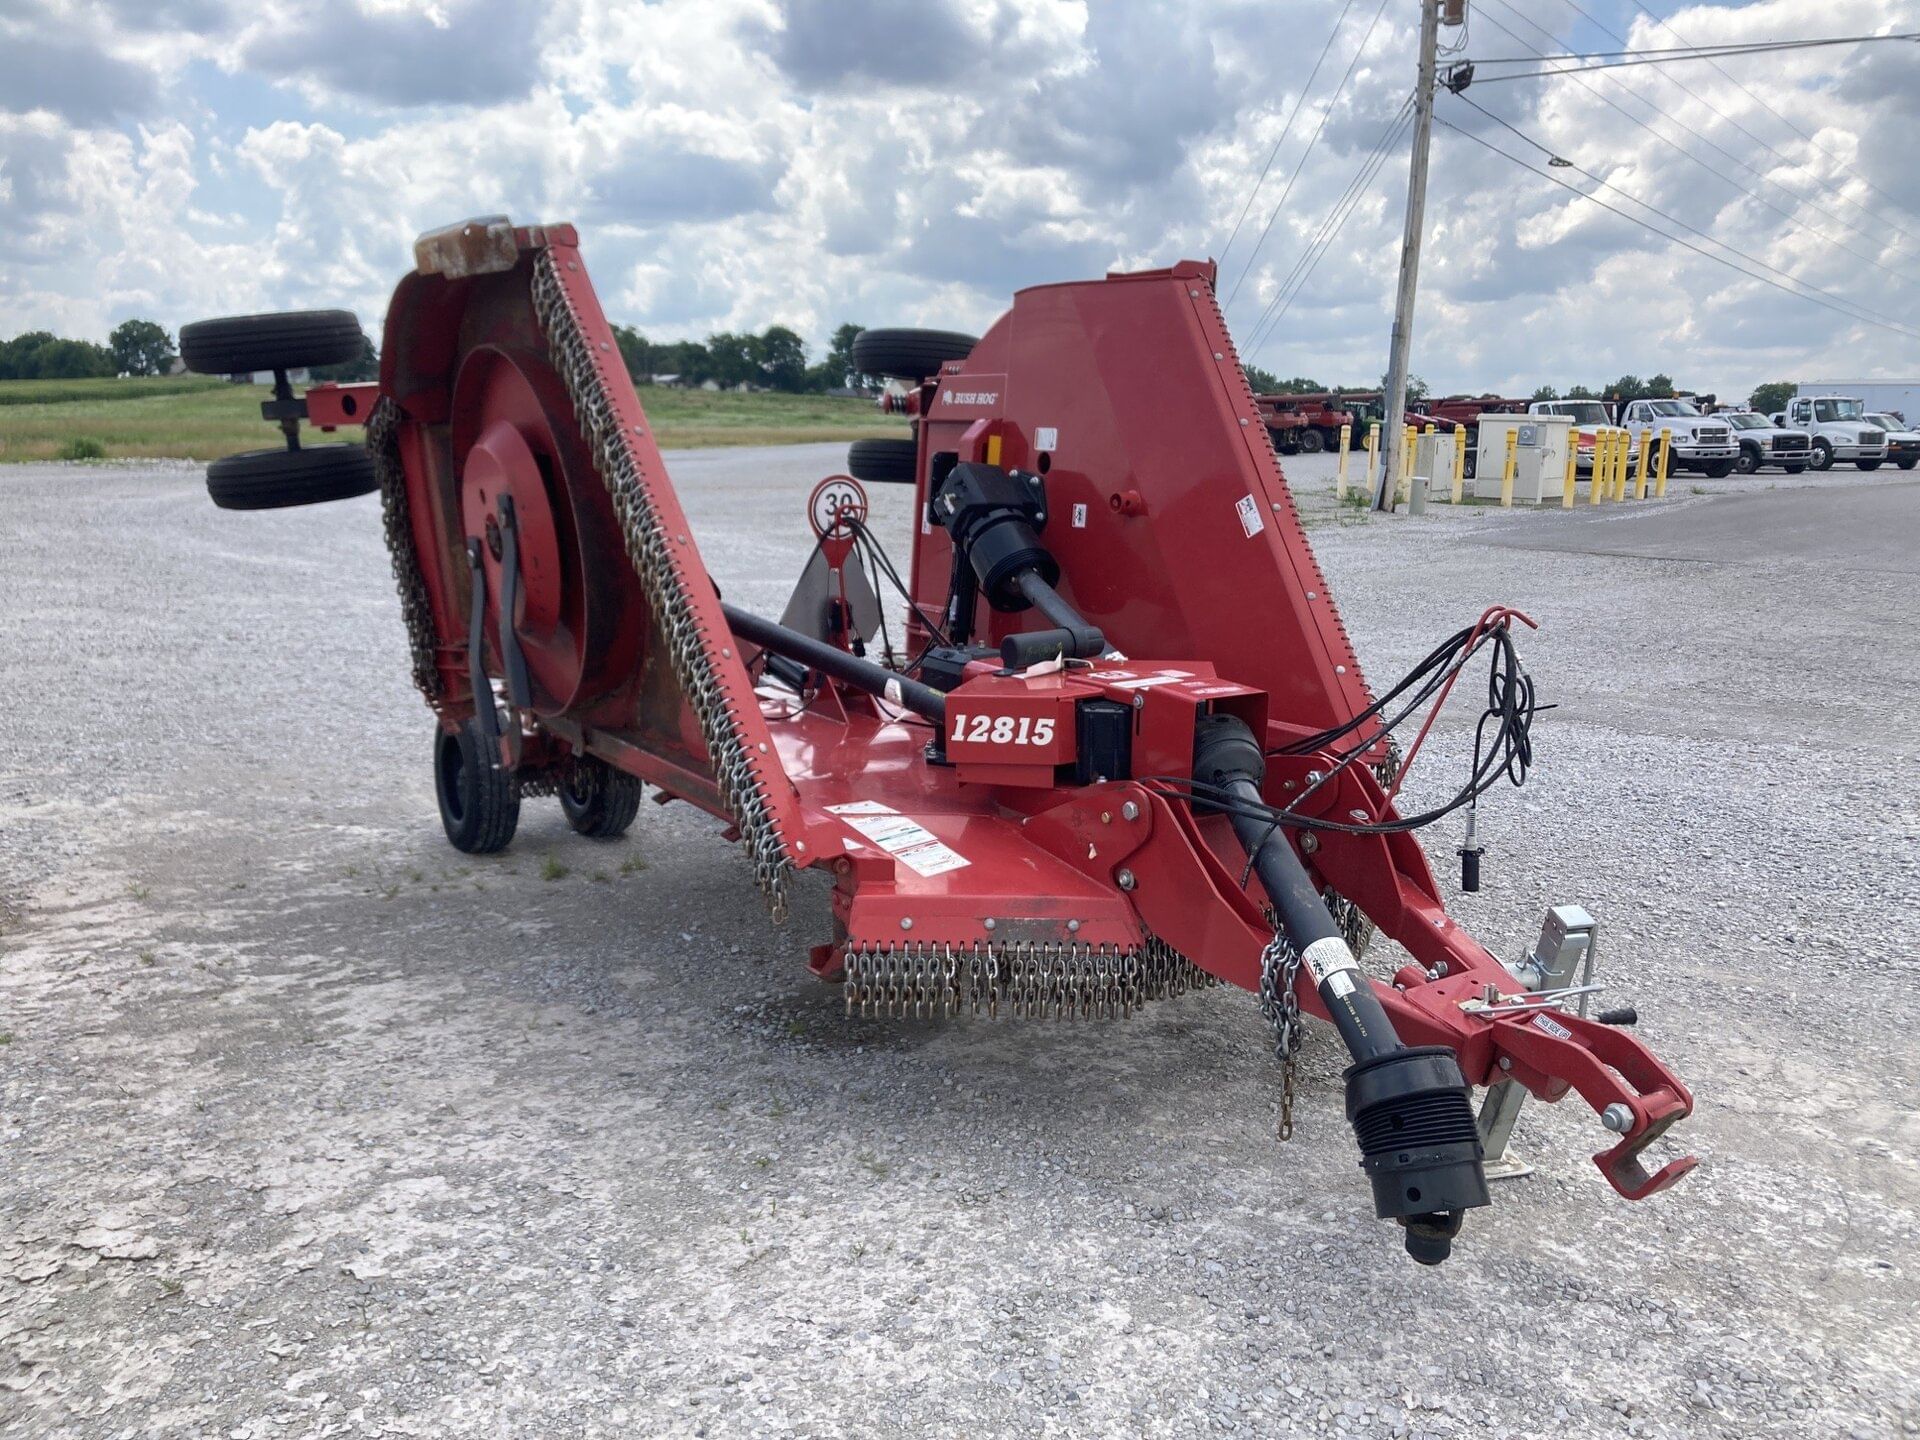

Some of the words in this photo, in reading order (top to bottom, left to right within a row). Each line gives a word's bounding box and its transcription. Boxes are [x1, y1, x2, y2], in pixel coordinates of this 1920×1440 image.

[954, 392, 977, 404] BUSH
[825, 493, 853, 516] 30
[950, 714, 1056, 746] 12815
[1538, 1015, 1550, 1027] THIS
[1548, 1022, 1561, 1034] SIDE
[1559, 1030, 1569, 1038] UP
